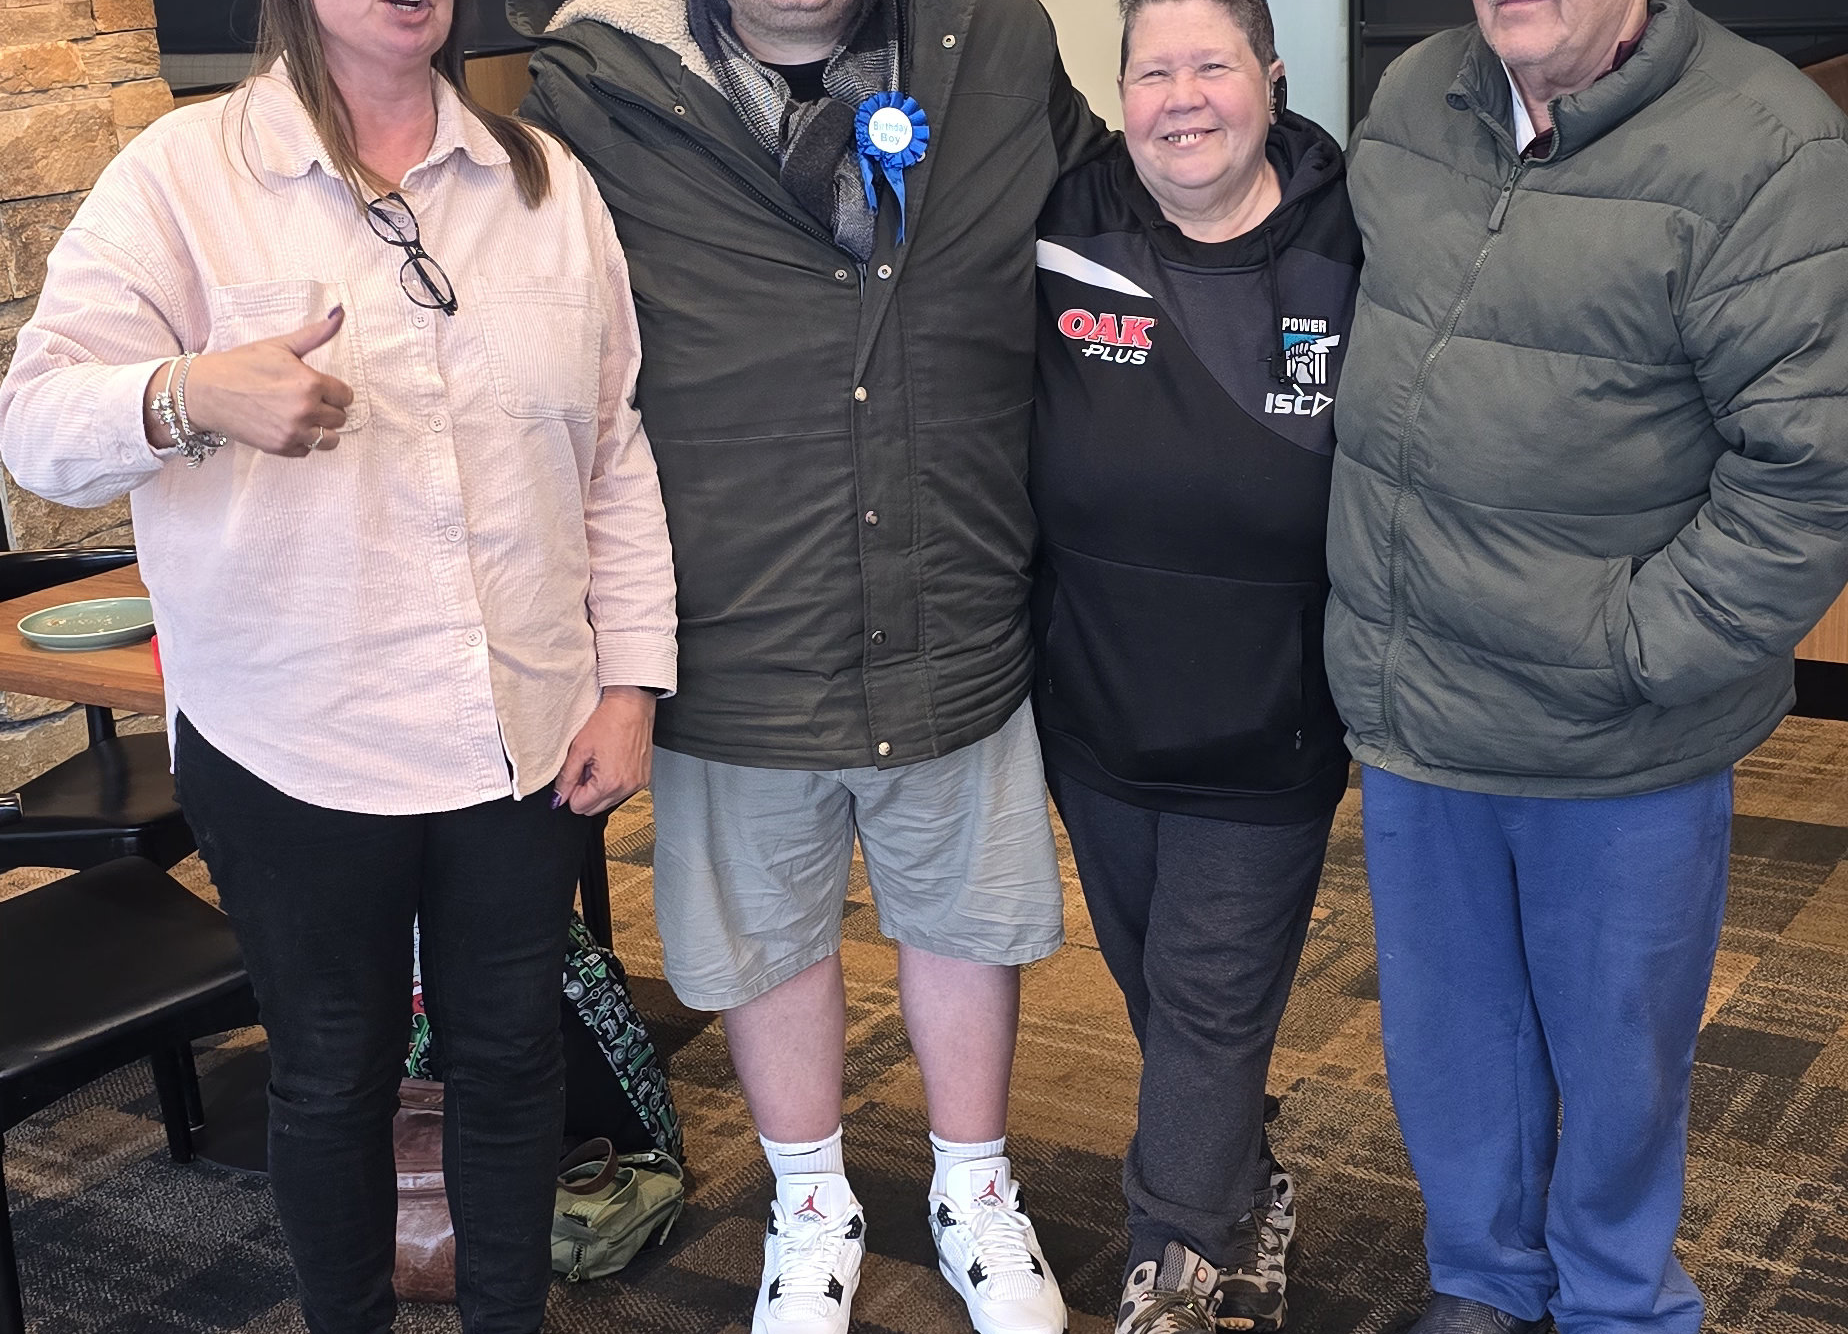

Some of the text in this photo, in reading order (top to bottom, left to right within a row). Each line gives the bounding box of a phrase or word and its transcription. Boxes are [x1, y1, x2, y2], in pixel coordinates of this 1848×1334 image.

[873, 120, 908, 134] Birthday
[880, 132, 900, 145] Boy
[1058, 308, 1153, 349] OAK
[1282, 317, 1327, 333] POWER
[1082, 343, 1148, 365] PLUS
